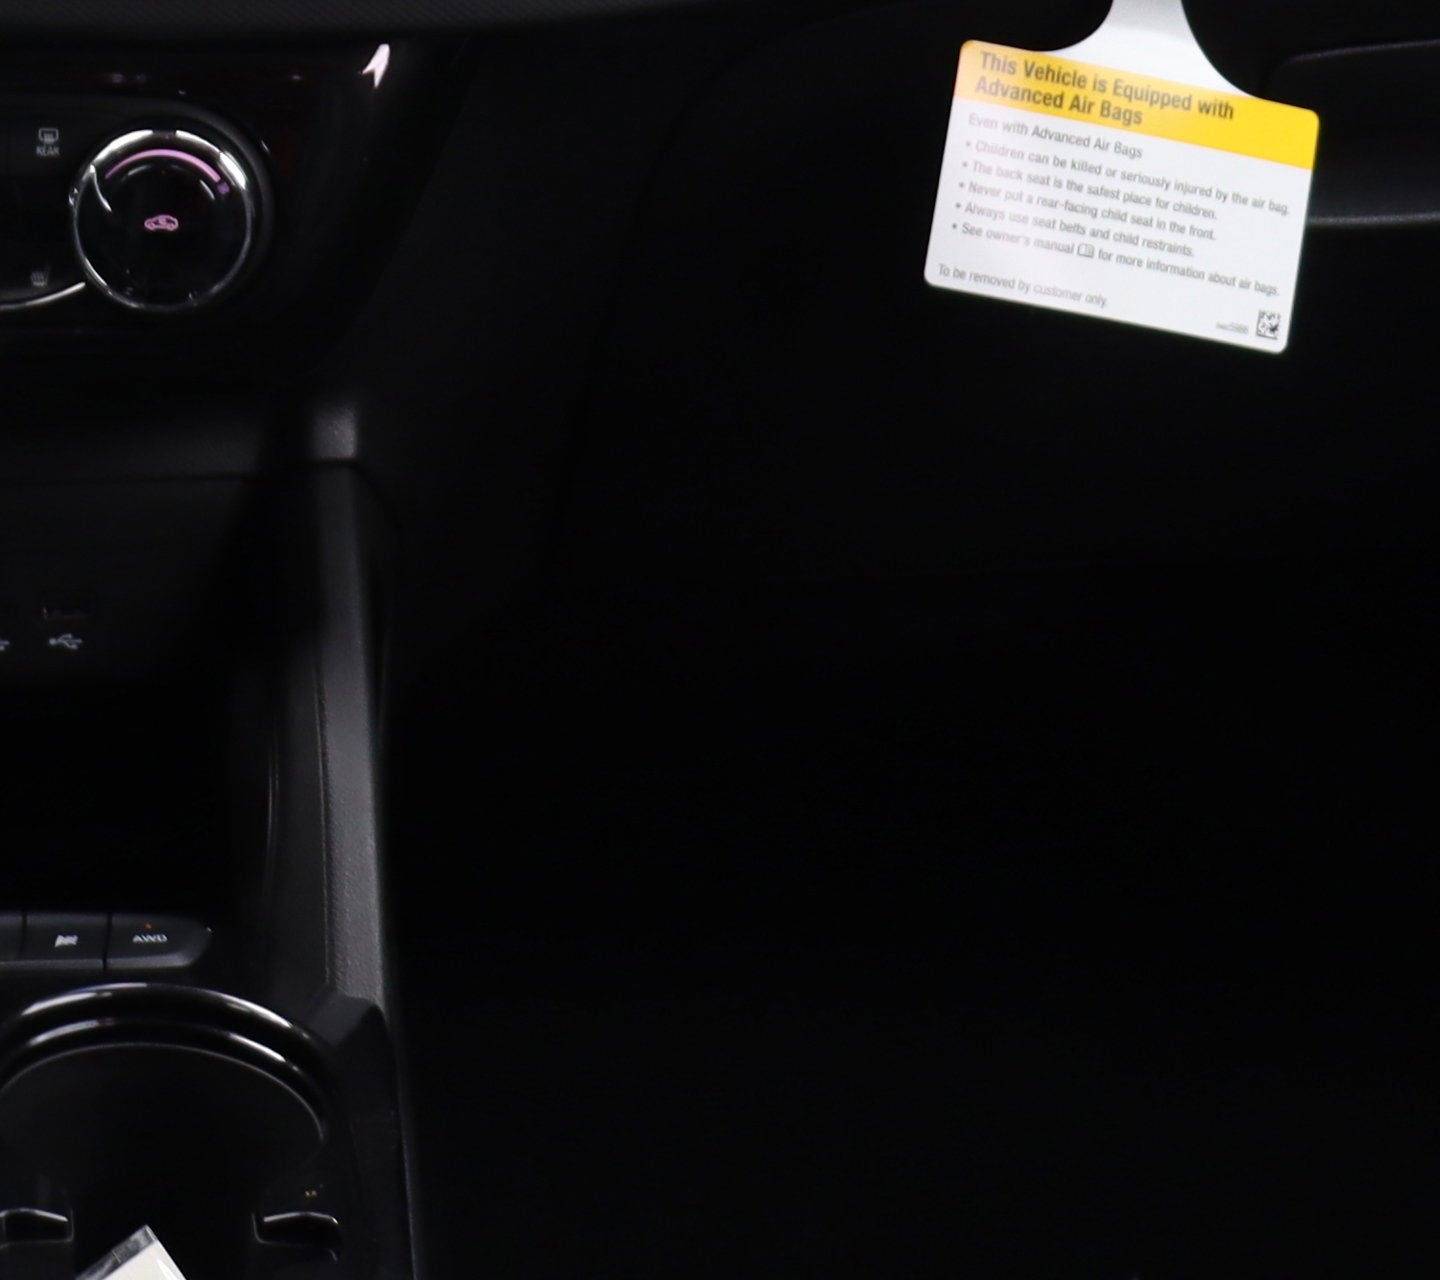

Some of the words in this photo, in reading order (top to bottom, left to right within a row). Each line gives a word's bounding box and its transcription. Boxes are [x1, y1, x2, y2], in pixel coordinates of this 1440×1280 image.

[975, 75, 1064, 109] Advanced
[1068, 94, 1094, 114] Air
[1098, 100, 1144, 128] Bags
[978, 51, 1018, 75] This
[1021, 60, 1088, 89] Vehicle
[1092, 74, 1108, 93] is
[1111, 78, 1193, 113] Equipped
[1196, 96, 1235, 120] with
[35, 144, 61, 157] REAR
[967, 112, 999, 130] Even
[1001, 119, 1029, 136] with
[1030, 125, 1091, 148] Advanced
[1092, 137, 1110, 152] Air
[1112, 141, 1143, 160] Bags
[971, 161, 993, 175] The
[1026, 172, 1051, 187] seat
[1065, 179, 1084, 193] the
[1085, 183, 1121, 201] safest
[1122, 190, 1153, 208] place
[1154, 197, 1170, 210] for
[974, 140, 1025, 161] Children
[1027, 152, 1049, 165] can
[1069, 159, 1102, 176] killed
[1119, 168, 1171, 191] seriously
[1172, 179, 1212, 199] injured
[1230, 191, 1250, 206] the
[1250, 196, 1266, 209] air
[963, 201, 1005, 222] Always
[1031, 215, 1056, 230] seat
[1058, 220, 1087, 236] belts
[1088, 226, 1110, 241] and
[1111, 230, 1139, 246] child
[967, 181, 1002, 198] Never
[1003, 189, 1024, 204] put
[1035, 194, 1098, 219] rear-facing
[1100, 207, 1128, 223] child
[1129, 213, 1154, 228] seat
[1167, 220, 1187, 235] the
[960, 222, 983, 237] See
[1032, 236, 1075, 255] manual
[1096, 249, 1113, 263] for
[1115, 254, 1143, 268] more
[1145, 258, 1206, 281] information
[1207, 271, 1237, 287] about
[1238, 277, 1252, 290] air
[968, 269, 1015, 289] removed
[1032, 283, 1082, 302] customer
[132, 933, 168, 944] AWD
